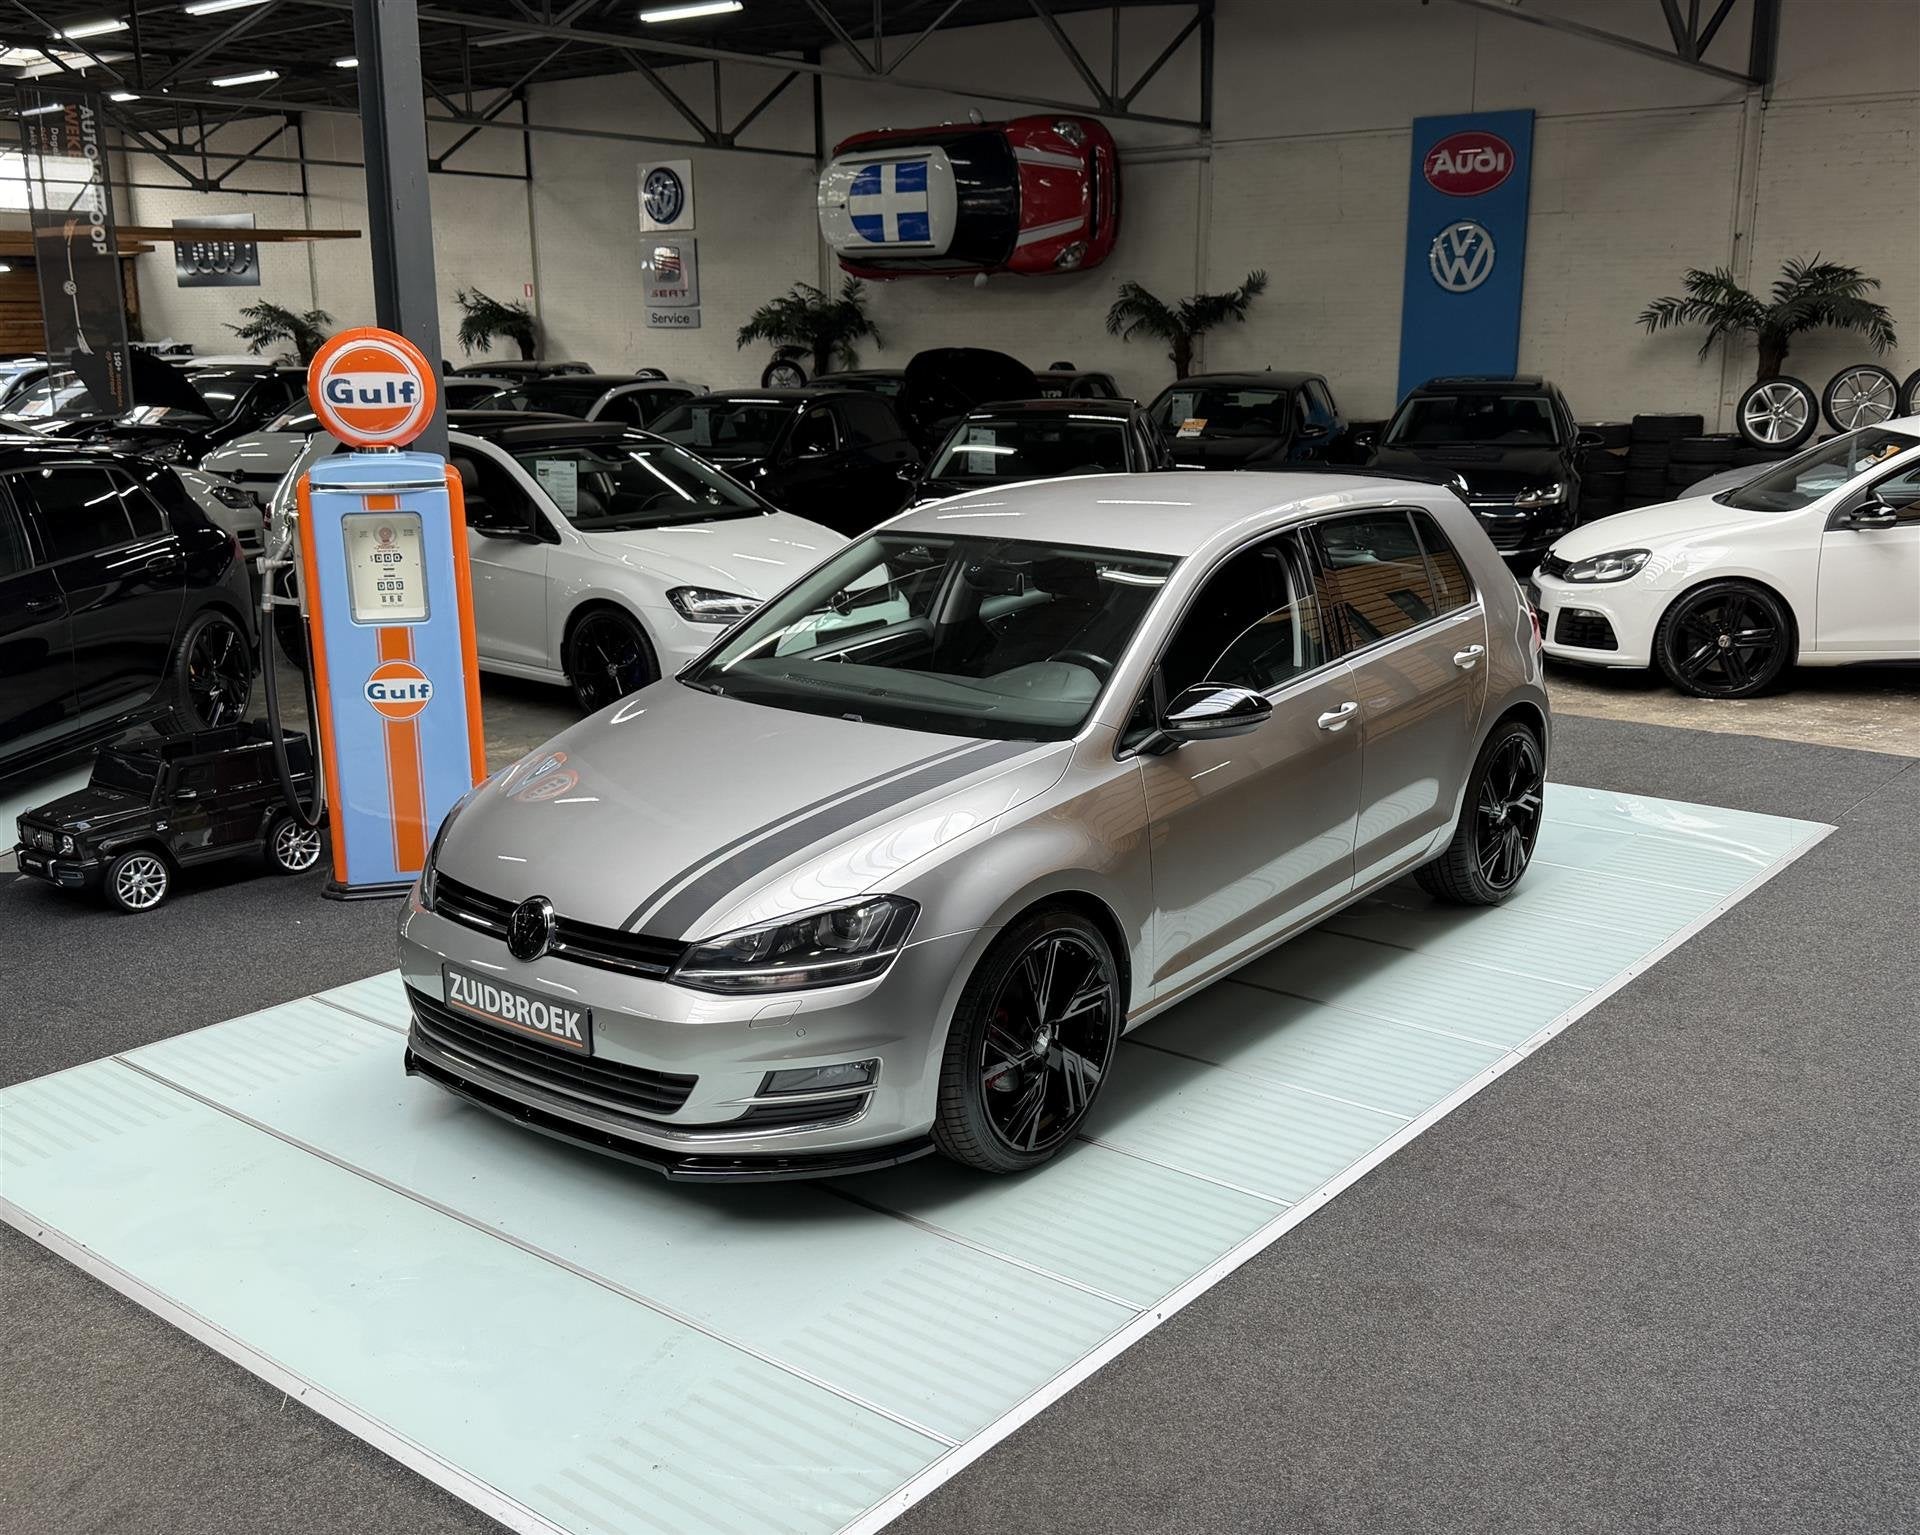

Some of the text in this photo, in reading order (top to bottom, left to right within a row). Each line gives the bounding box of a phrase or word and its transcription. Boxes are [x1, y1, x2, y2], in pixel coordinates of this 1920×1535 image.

[652, 312, 690, 324] Service
[327, 378, 415, 404] Gulf
[367, 683, 430, 699] Gulf
[449, 971, 583, 1041] ZUIDBROEK
